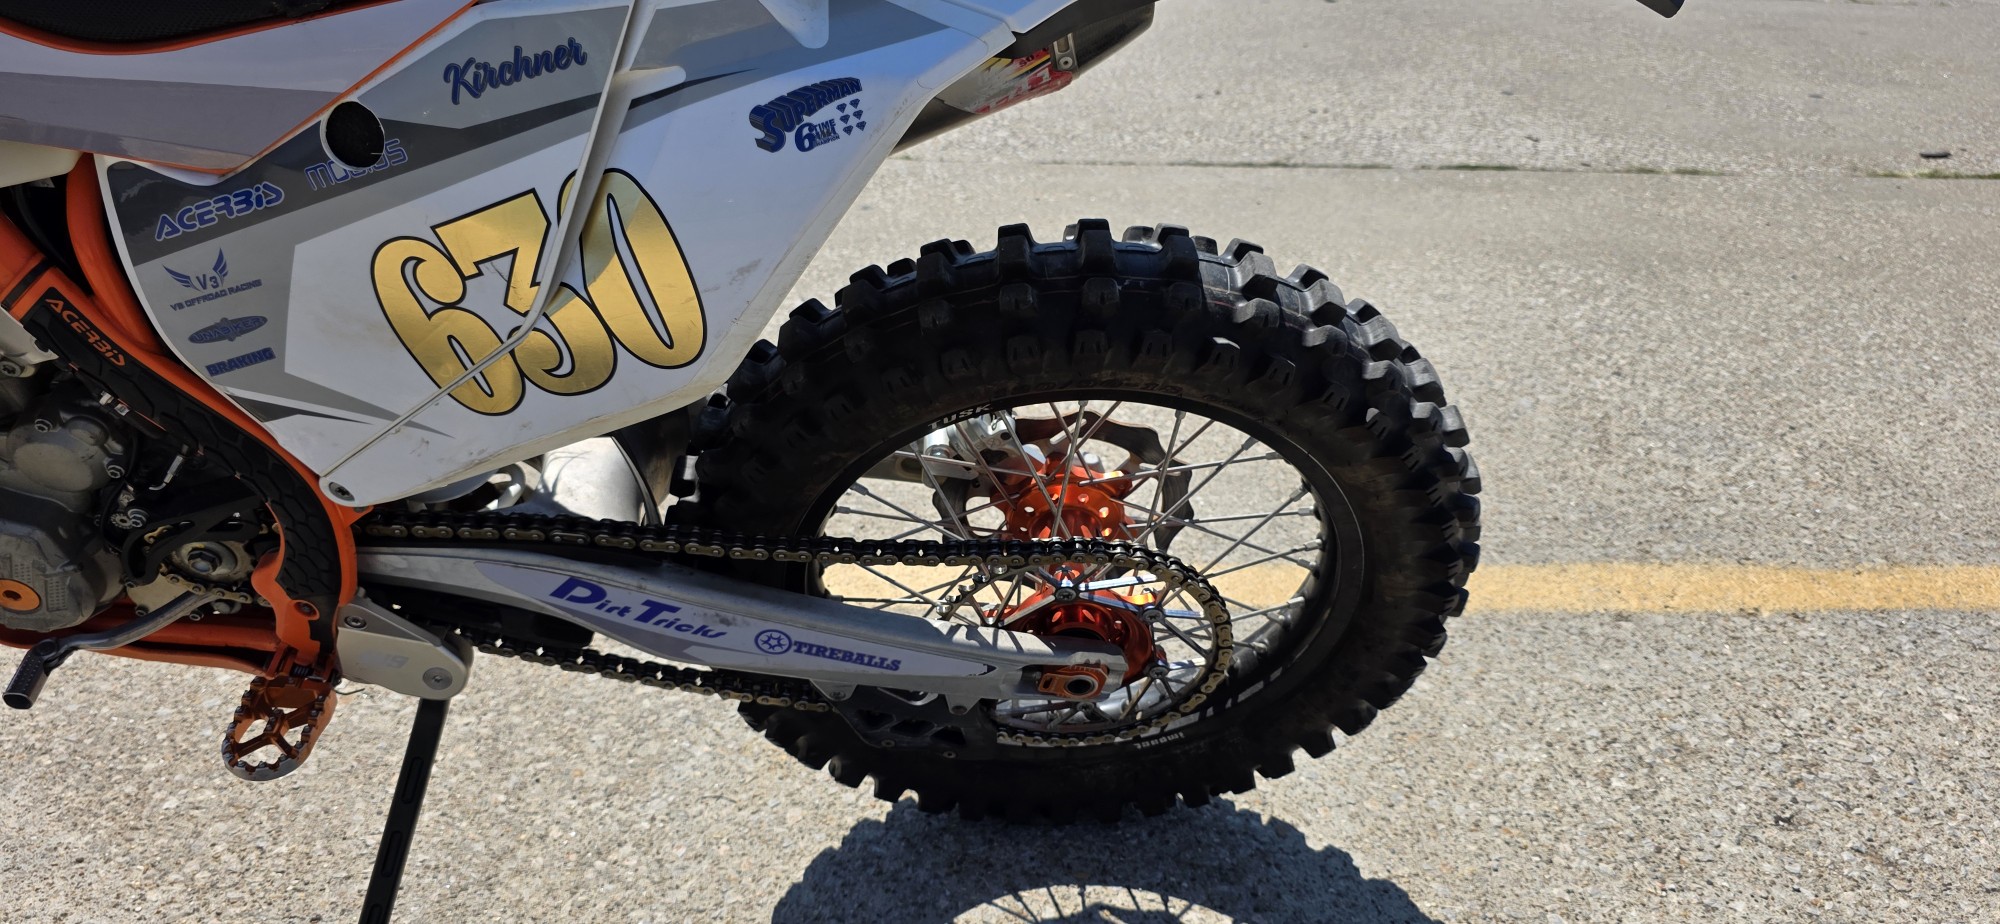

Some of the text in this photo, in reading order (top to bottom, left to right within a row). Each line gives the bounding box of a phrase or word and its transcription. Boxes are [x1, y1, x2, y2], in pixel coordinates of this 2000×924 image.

[443, 37, 587, 105] Kirchner
[749, 77, 862, 153] SUPERMAN
[155, 181, 285, 241] ACERBIS
[185, 289, 228, 307] OFFROAD
[228, 279, 262, 295] RACING
[196, 273, 219, 290] V3
[371, 168, 707, 416] 630
[45, 298, 126, 367] ACERBIS
[206, 347, 276, 377] BRAKING
[927, 403, 993, 430] TUSK
[549, 576, 728, 639] Dirt Tricks
[793, 640, 901, 672] TIREBALLS
